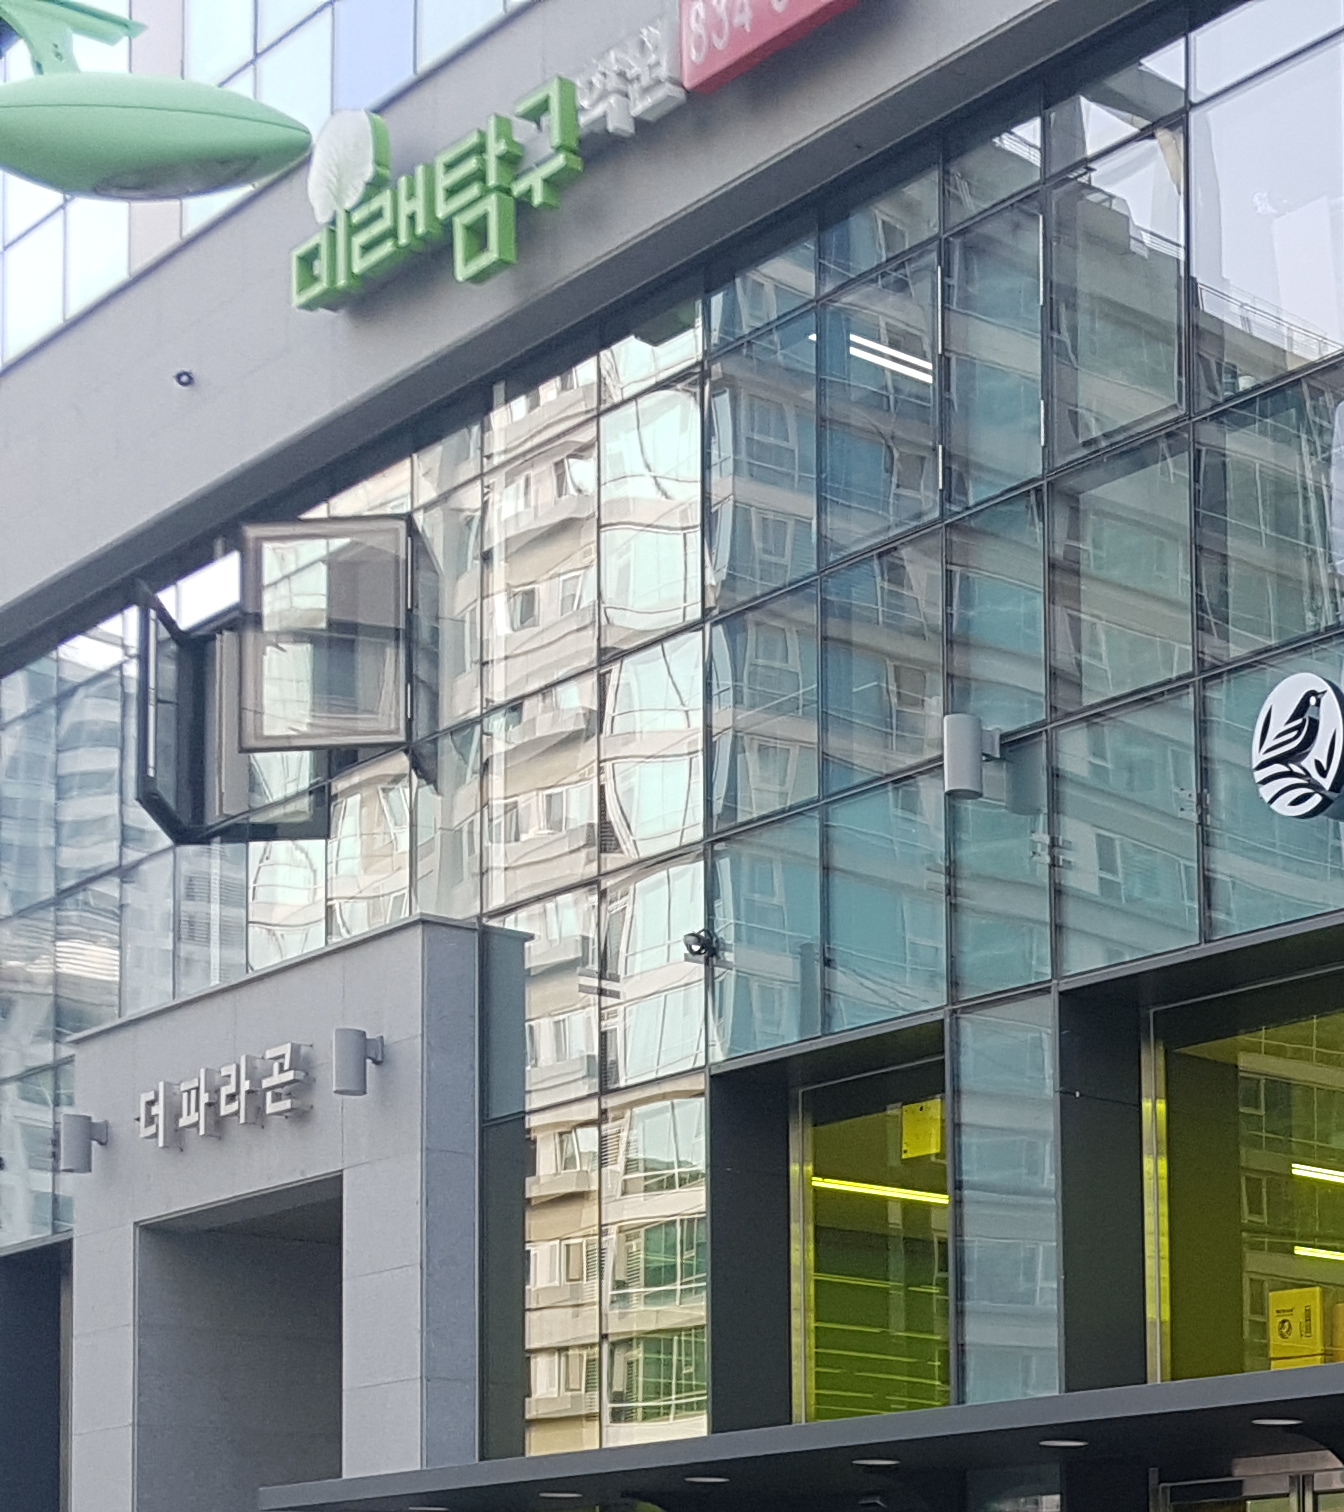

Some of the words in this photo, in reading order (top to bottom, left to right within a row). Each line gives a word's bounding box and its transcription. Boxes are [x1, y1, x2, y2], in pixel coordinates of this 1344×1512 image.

[291, 76, 584, 312] 미래탐구
[139, 1080, 166, 1148] 더
[178, 1042, 302, 1137] 파라곤
